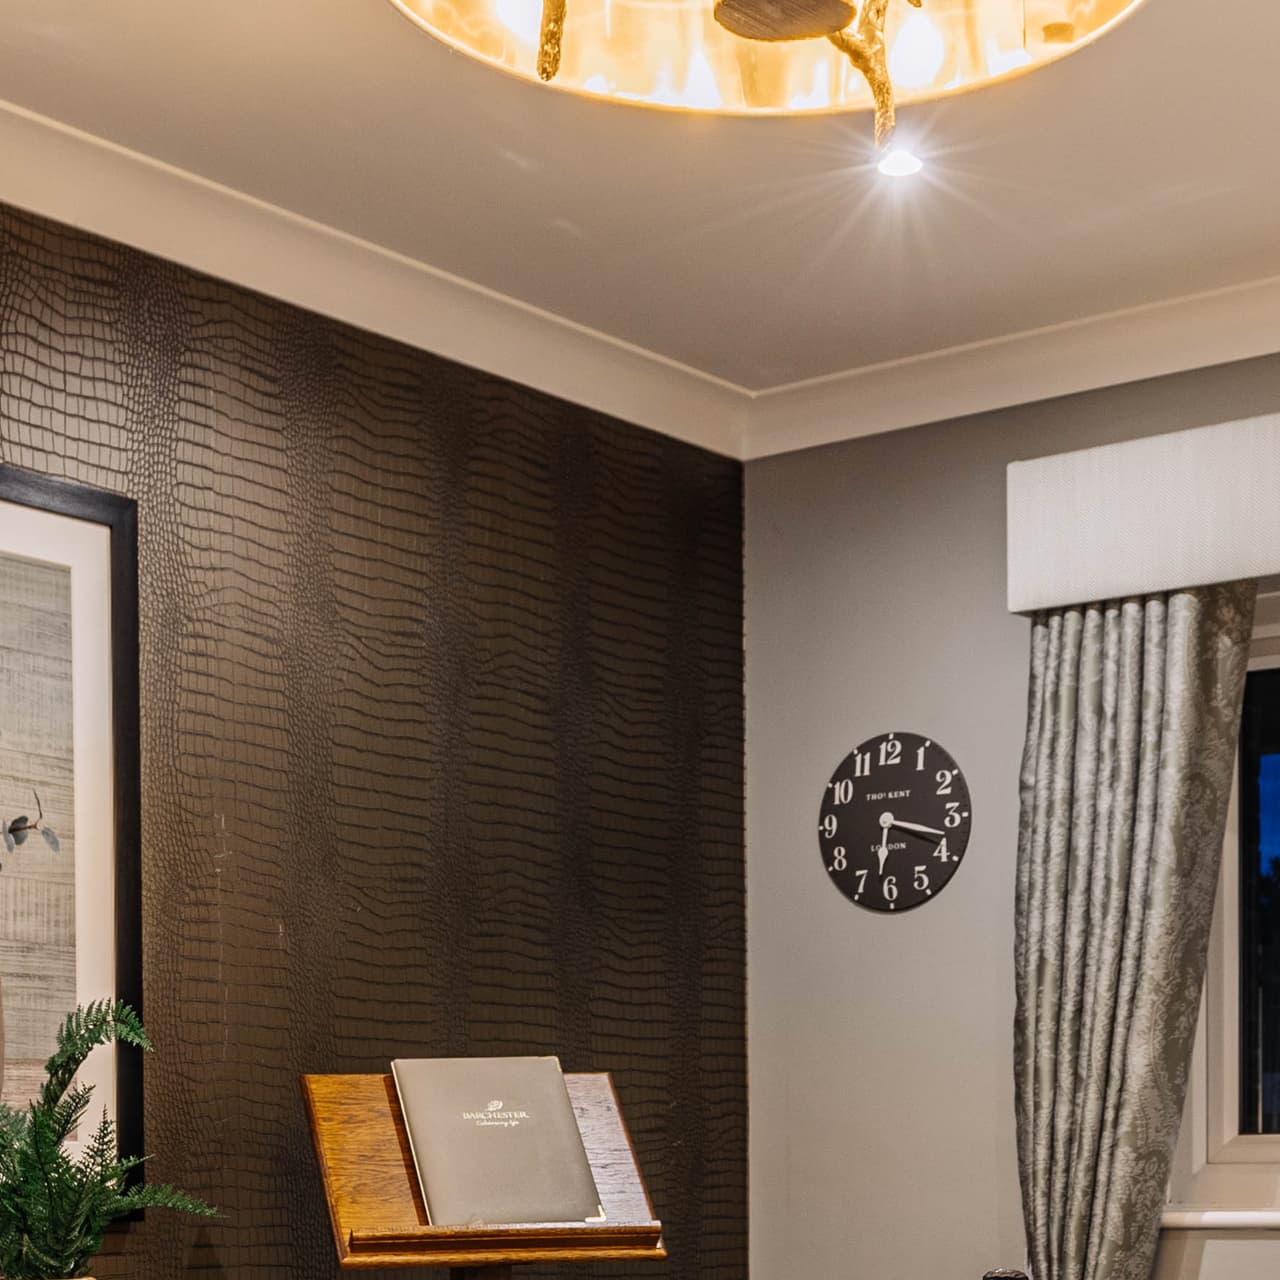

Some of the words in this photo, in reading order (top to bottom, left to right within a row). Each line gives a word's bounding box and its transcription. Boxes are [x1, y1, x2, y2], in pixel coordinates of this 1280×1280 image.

[854, 752, 871, 777] 11
[878, 740, 902, 766] 12
[915, 746, 926, 771] 1
[833, 779, 853, 805] 10
[935, 770, 952, 796] 2
[824, 814, 838, 839] 9
[944, 802, 961, 828] 3
[833, 846, 847, 871] 8
[870, 842, 907, 852] LODON
[933, 837, 950, 863] 4
[855, 870, 869, 893] 7
[883, 876, 898, 901] 6
[913, 865, 930, 890] 5
